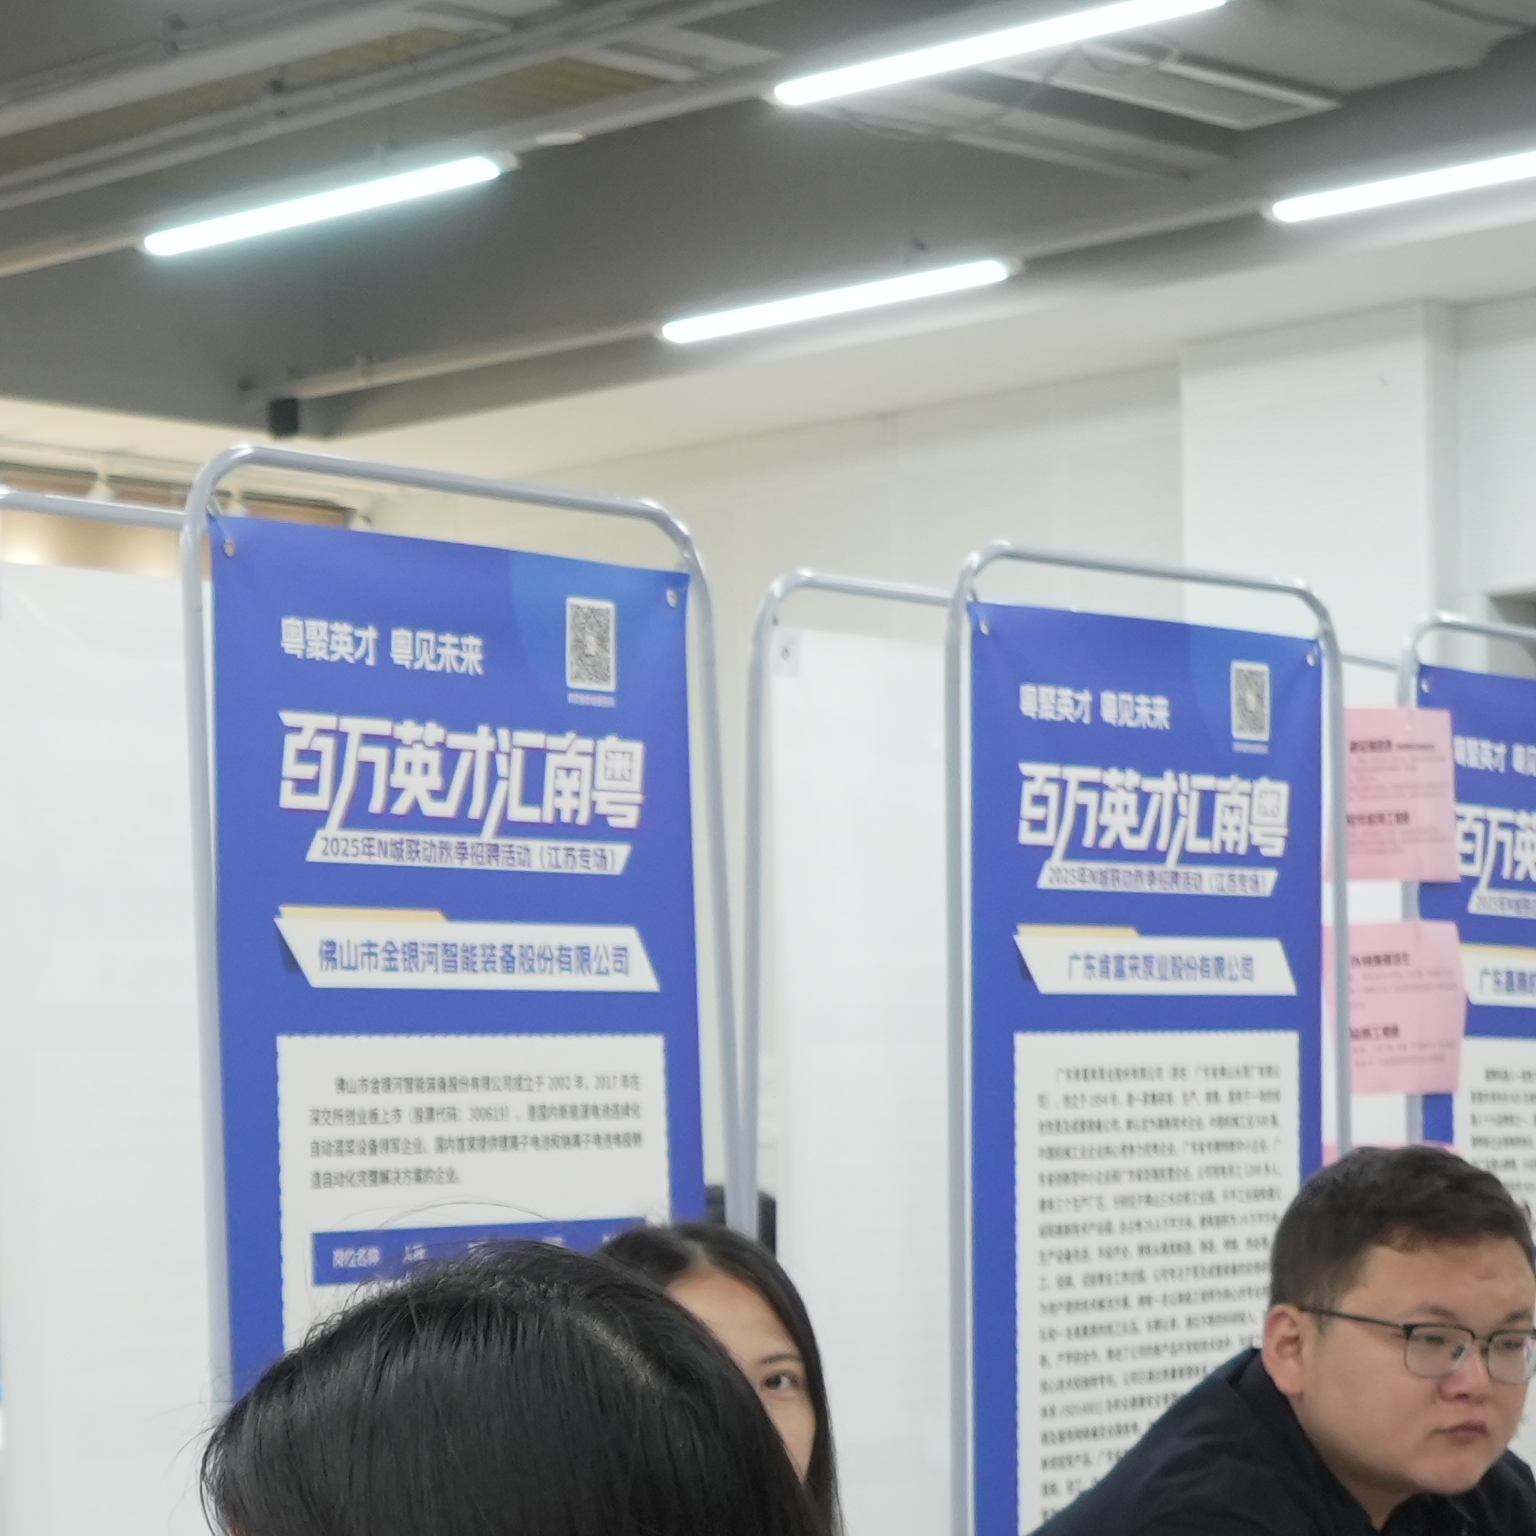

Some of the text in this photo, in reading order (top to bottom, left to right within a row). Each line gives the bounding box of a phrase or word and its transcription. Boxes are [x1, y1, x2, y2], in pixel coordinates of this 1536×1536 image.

[281, 617, 483, 675] 粤聚英才 粤见未来
[279, 710, 644, 829] 百万英才汇南粤
[1018, 762, 1289, 857] 百万英才汇南粤
[319, 940, 628, 975] 佛山市金银河智能装备股份有限公司
